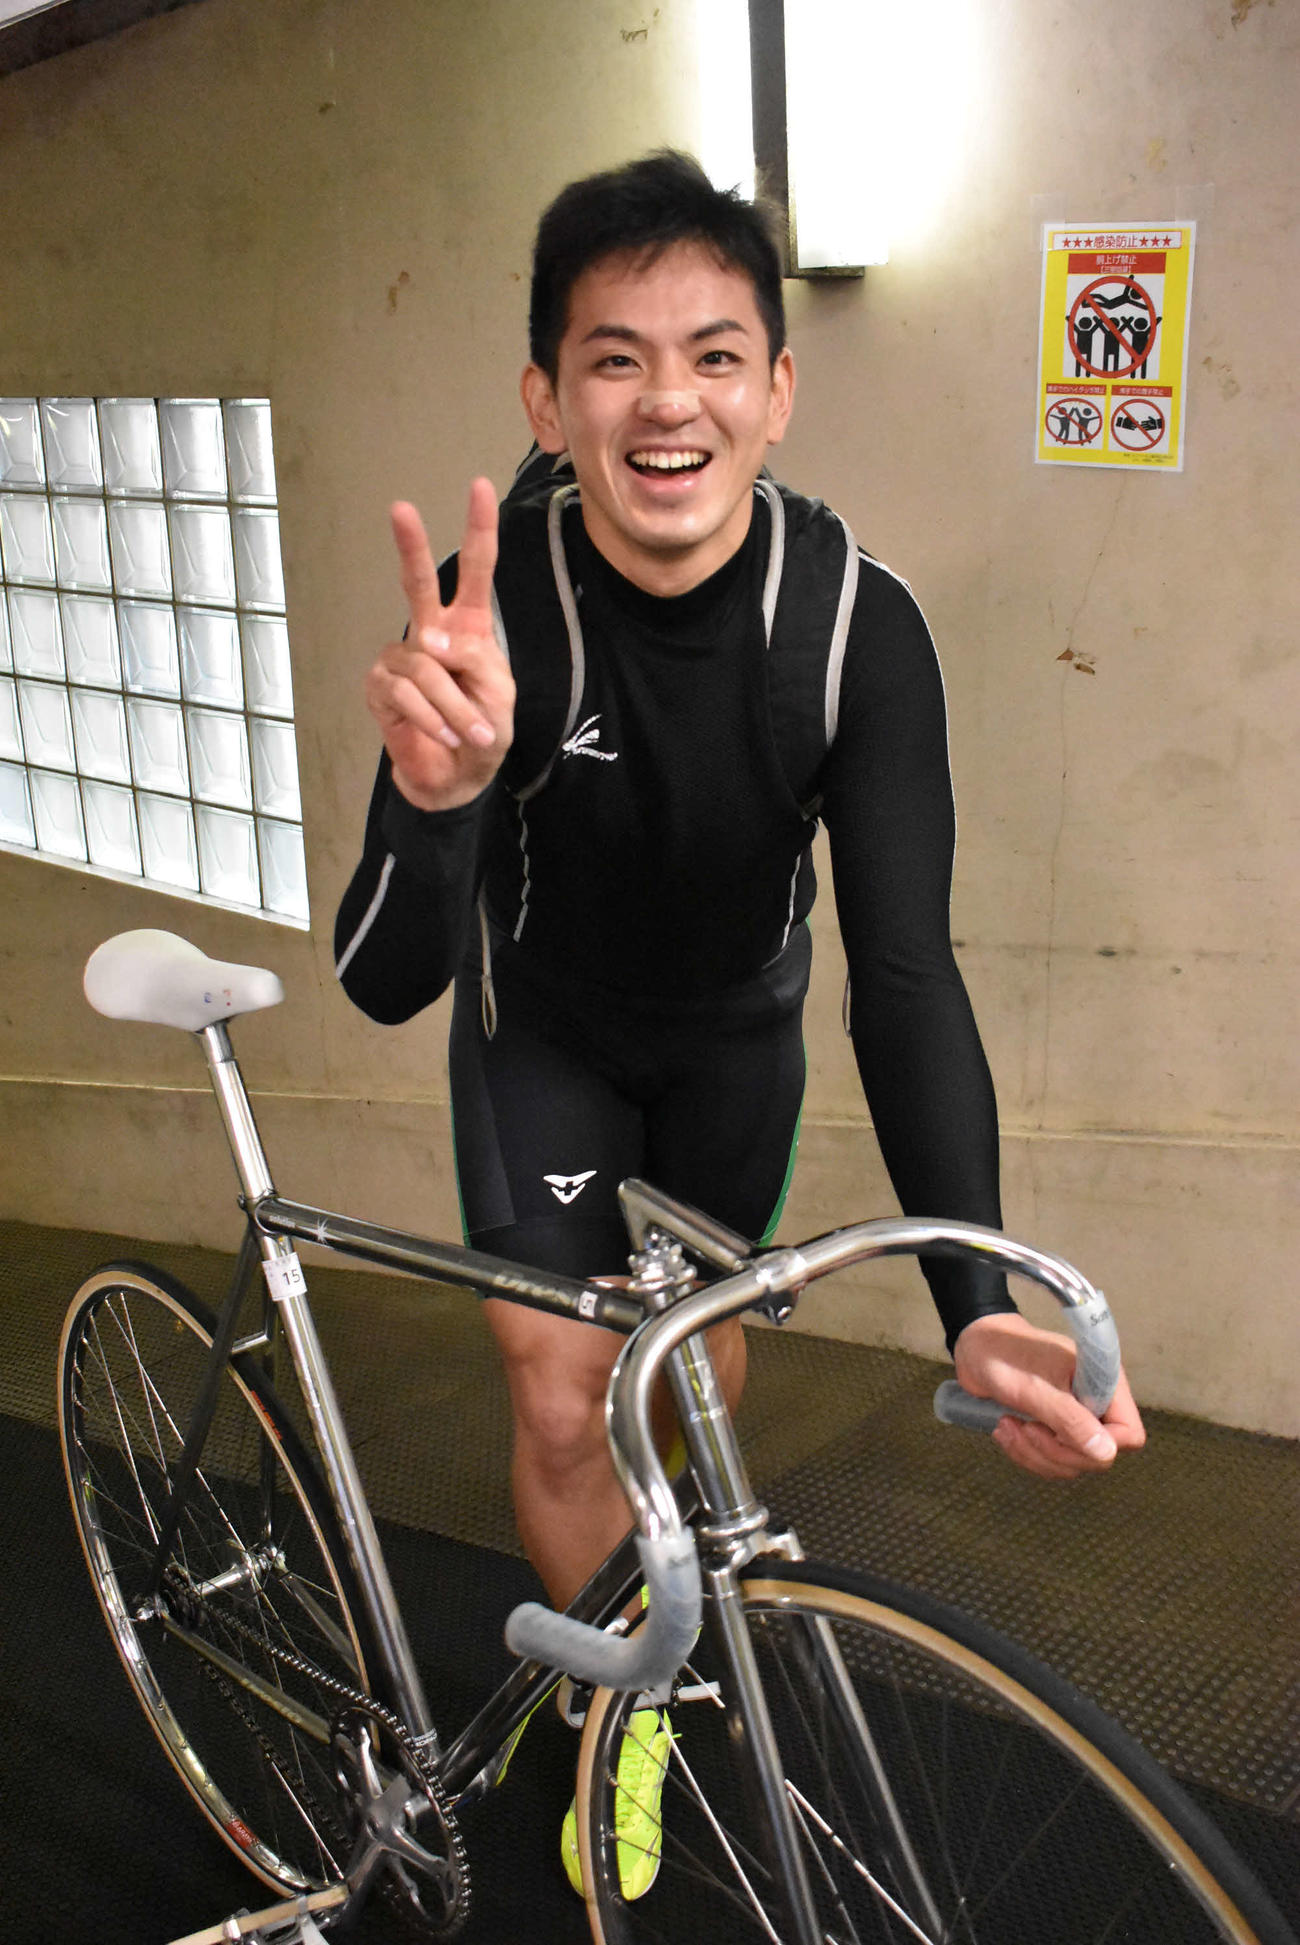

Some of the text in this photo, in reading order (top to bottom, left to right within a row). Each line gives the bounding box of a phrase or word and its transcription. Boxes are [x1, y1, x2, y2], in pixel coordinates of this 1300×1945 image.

[1093, 235, 1138, 249] 感染防止
[282, 1269, 301, 1286] 15
